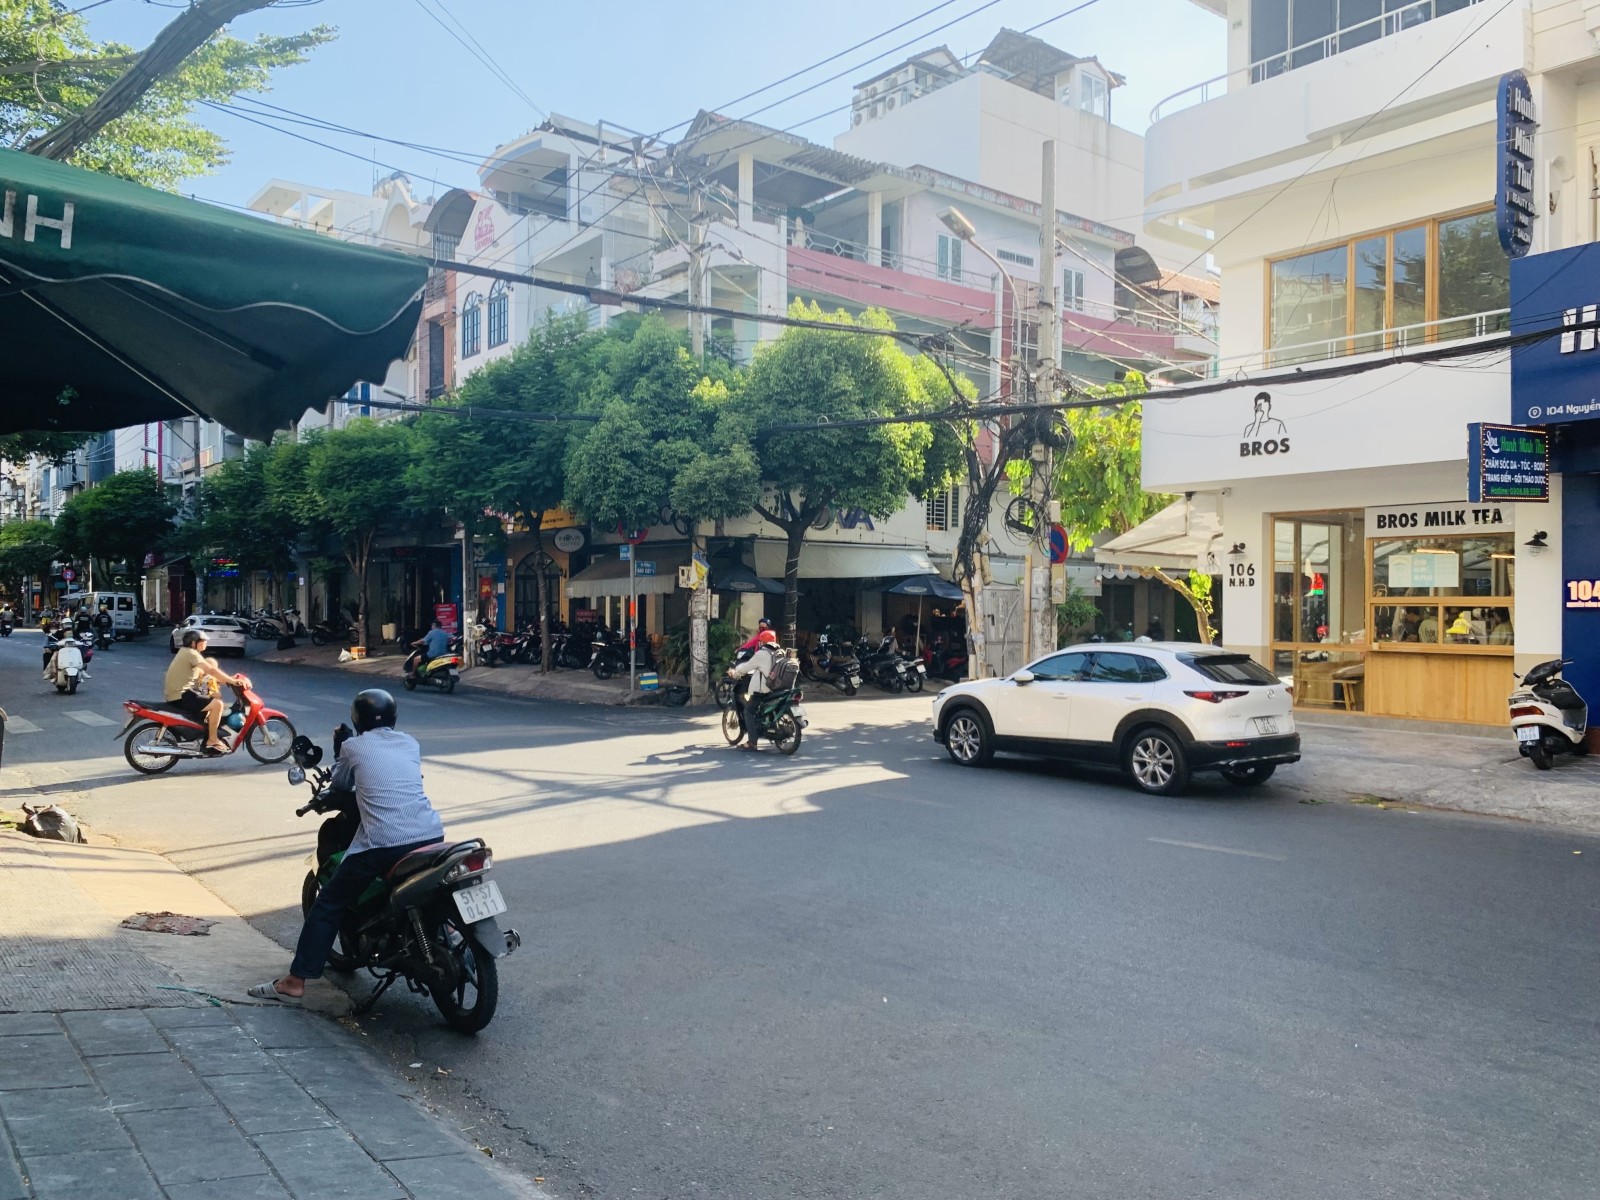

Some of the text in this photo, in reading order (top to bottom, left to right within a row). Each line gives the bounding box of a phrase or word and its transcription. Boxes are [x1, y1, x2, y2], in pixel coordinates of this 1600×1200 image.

[1546, 405, 1564, 416] 104
[1240, 438, 1290, 457] BROS
[1499, 457, 1510, 470] SÓC
[1520, 459, 1531, 470] TÓC
[1533, 461, 1546, 472] BODY
[1377, 508, 1503, 529] BROS MILK TEA
[1229, 563, 1255, 576] 106
[1229, 578, 1255, 587] N.H.D
